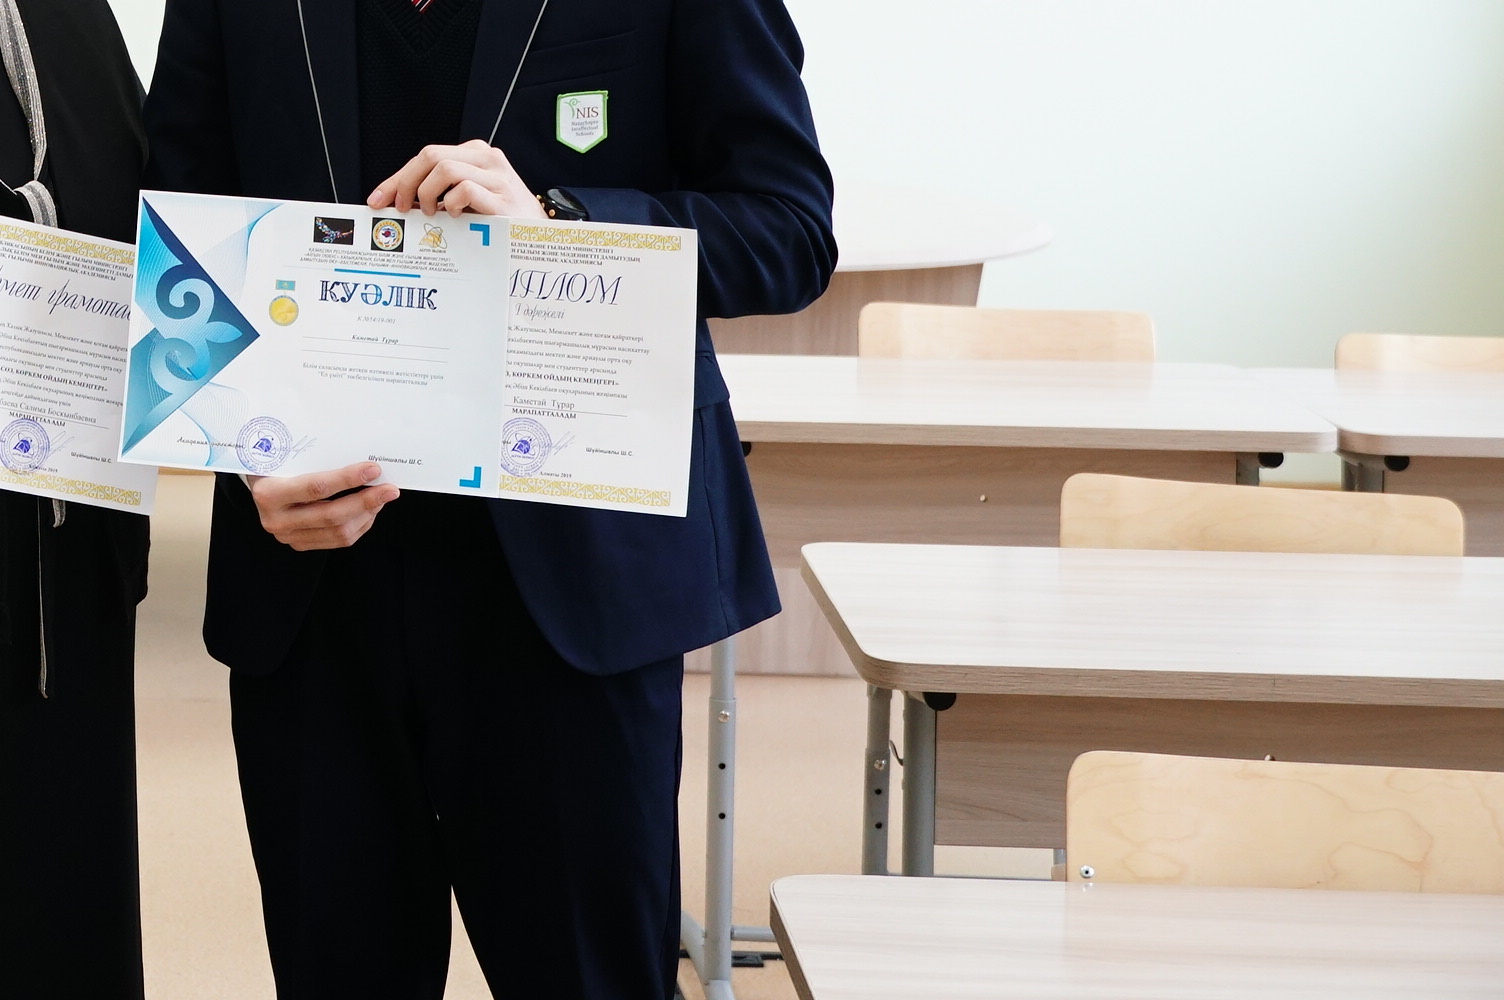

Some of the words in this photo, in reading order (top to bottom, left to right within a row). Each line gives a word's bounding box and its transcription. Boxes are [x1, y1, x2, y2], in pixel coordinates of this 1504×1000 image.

[576, 106, 599, 119] NIS
[510, 268, 622, 306] ПЛОМ
[47, 279, 130, 320] грамота
[319, 280, 437, 310] КУӘЛІК
[507, 336, 543, 345] екілбаевтың
[513, 396, 546, 406] Каметай
[551, 399, 575, 410] Тұрар
[512, 408, 576, 419] МАРАПАТТАЛАДЫ
